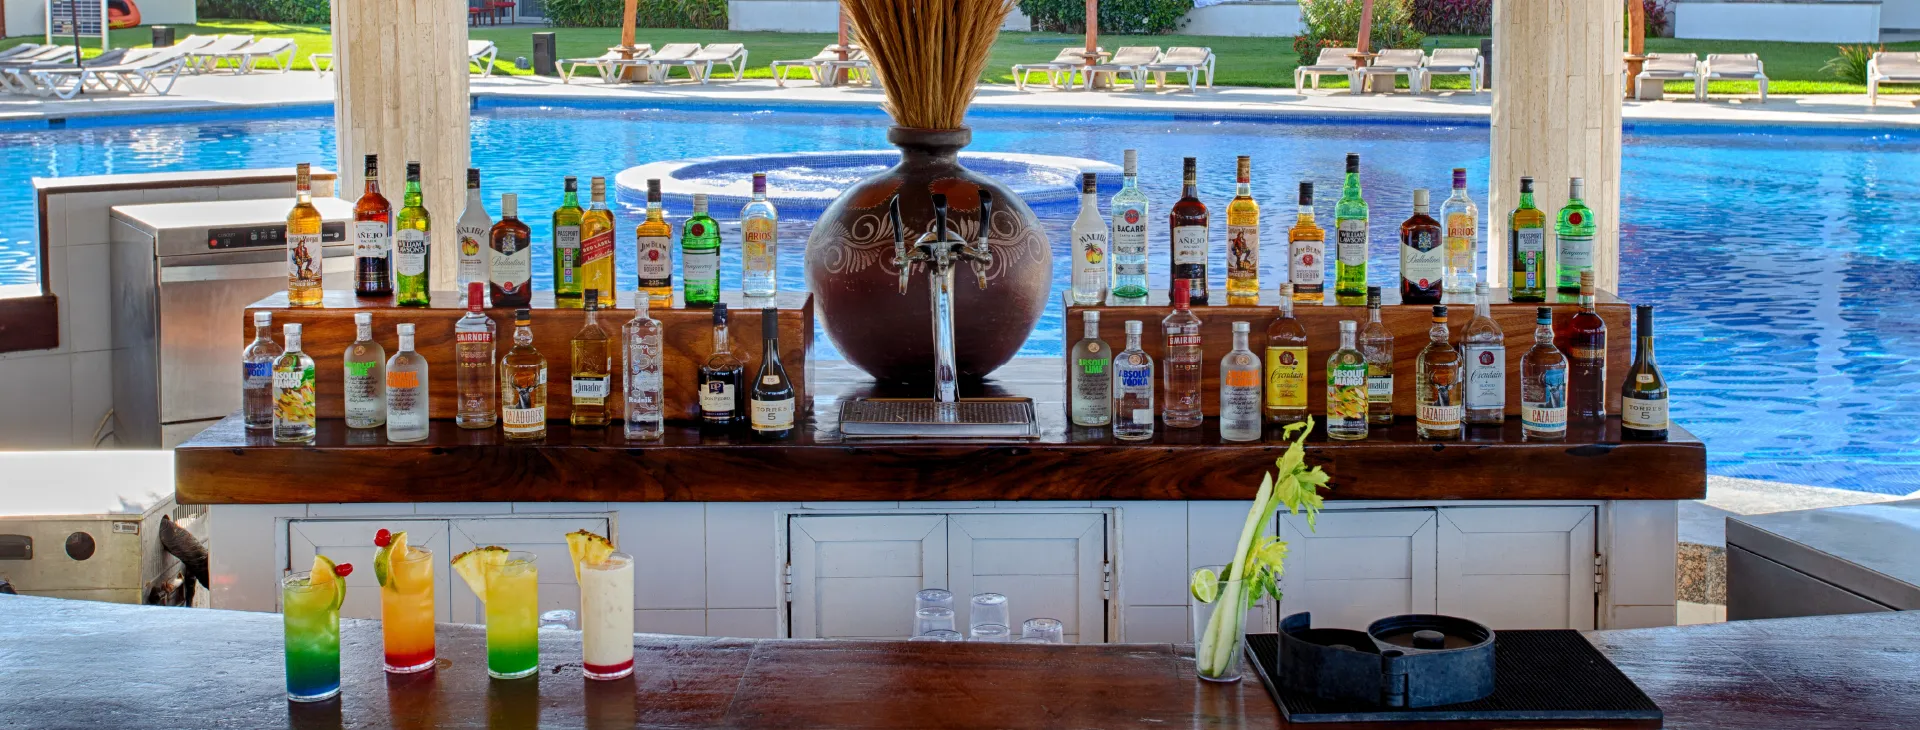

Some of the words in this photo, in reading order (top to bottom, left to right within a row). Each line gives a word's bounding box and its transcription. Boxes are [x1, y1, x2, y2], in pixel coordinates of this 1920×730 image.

[357, 231, 383, 239] AÑEJO
[456, 226, 487, 238] MALIBU
[745, 231, 772, 242] LARIOS
[1448, 227, 1475, 237] LARIOS
[1178, 236, 1205, 244] AÑEJO
[582, 245, 594, 253] RED
[594, 239, 612, 249] LABEL
[640, 242, 650, 252] JIM
[650, 240, 667, 251] BEAM
[1294, 248, 1305, 257] JIM
[1305, 245, 1321, 256] BEAM
[456, 333, 490, 341] SMIRNOFF
[1084, 365, 1104, 374] LIME
[1332, 369, 1366, 378] ABSOLUT
[1118, 370, 1151, 379] ABSOLUT
[1121, 378, 1149, 387] VODKA
[1334, 377, 1364, 386] MANGO
[505, 408, 543, 425] CAZADORES
[767, 412, 776, 420] 5
[1422, 406, 1459, 422] CAZADORES
[1640, 412, 1651, 420] 5
